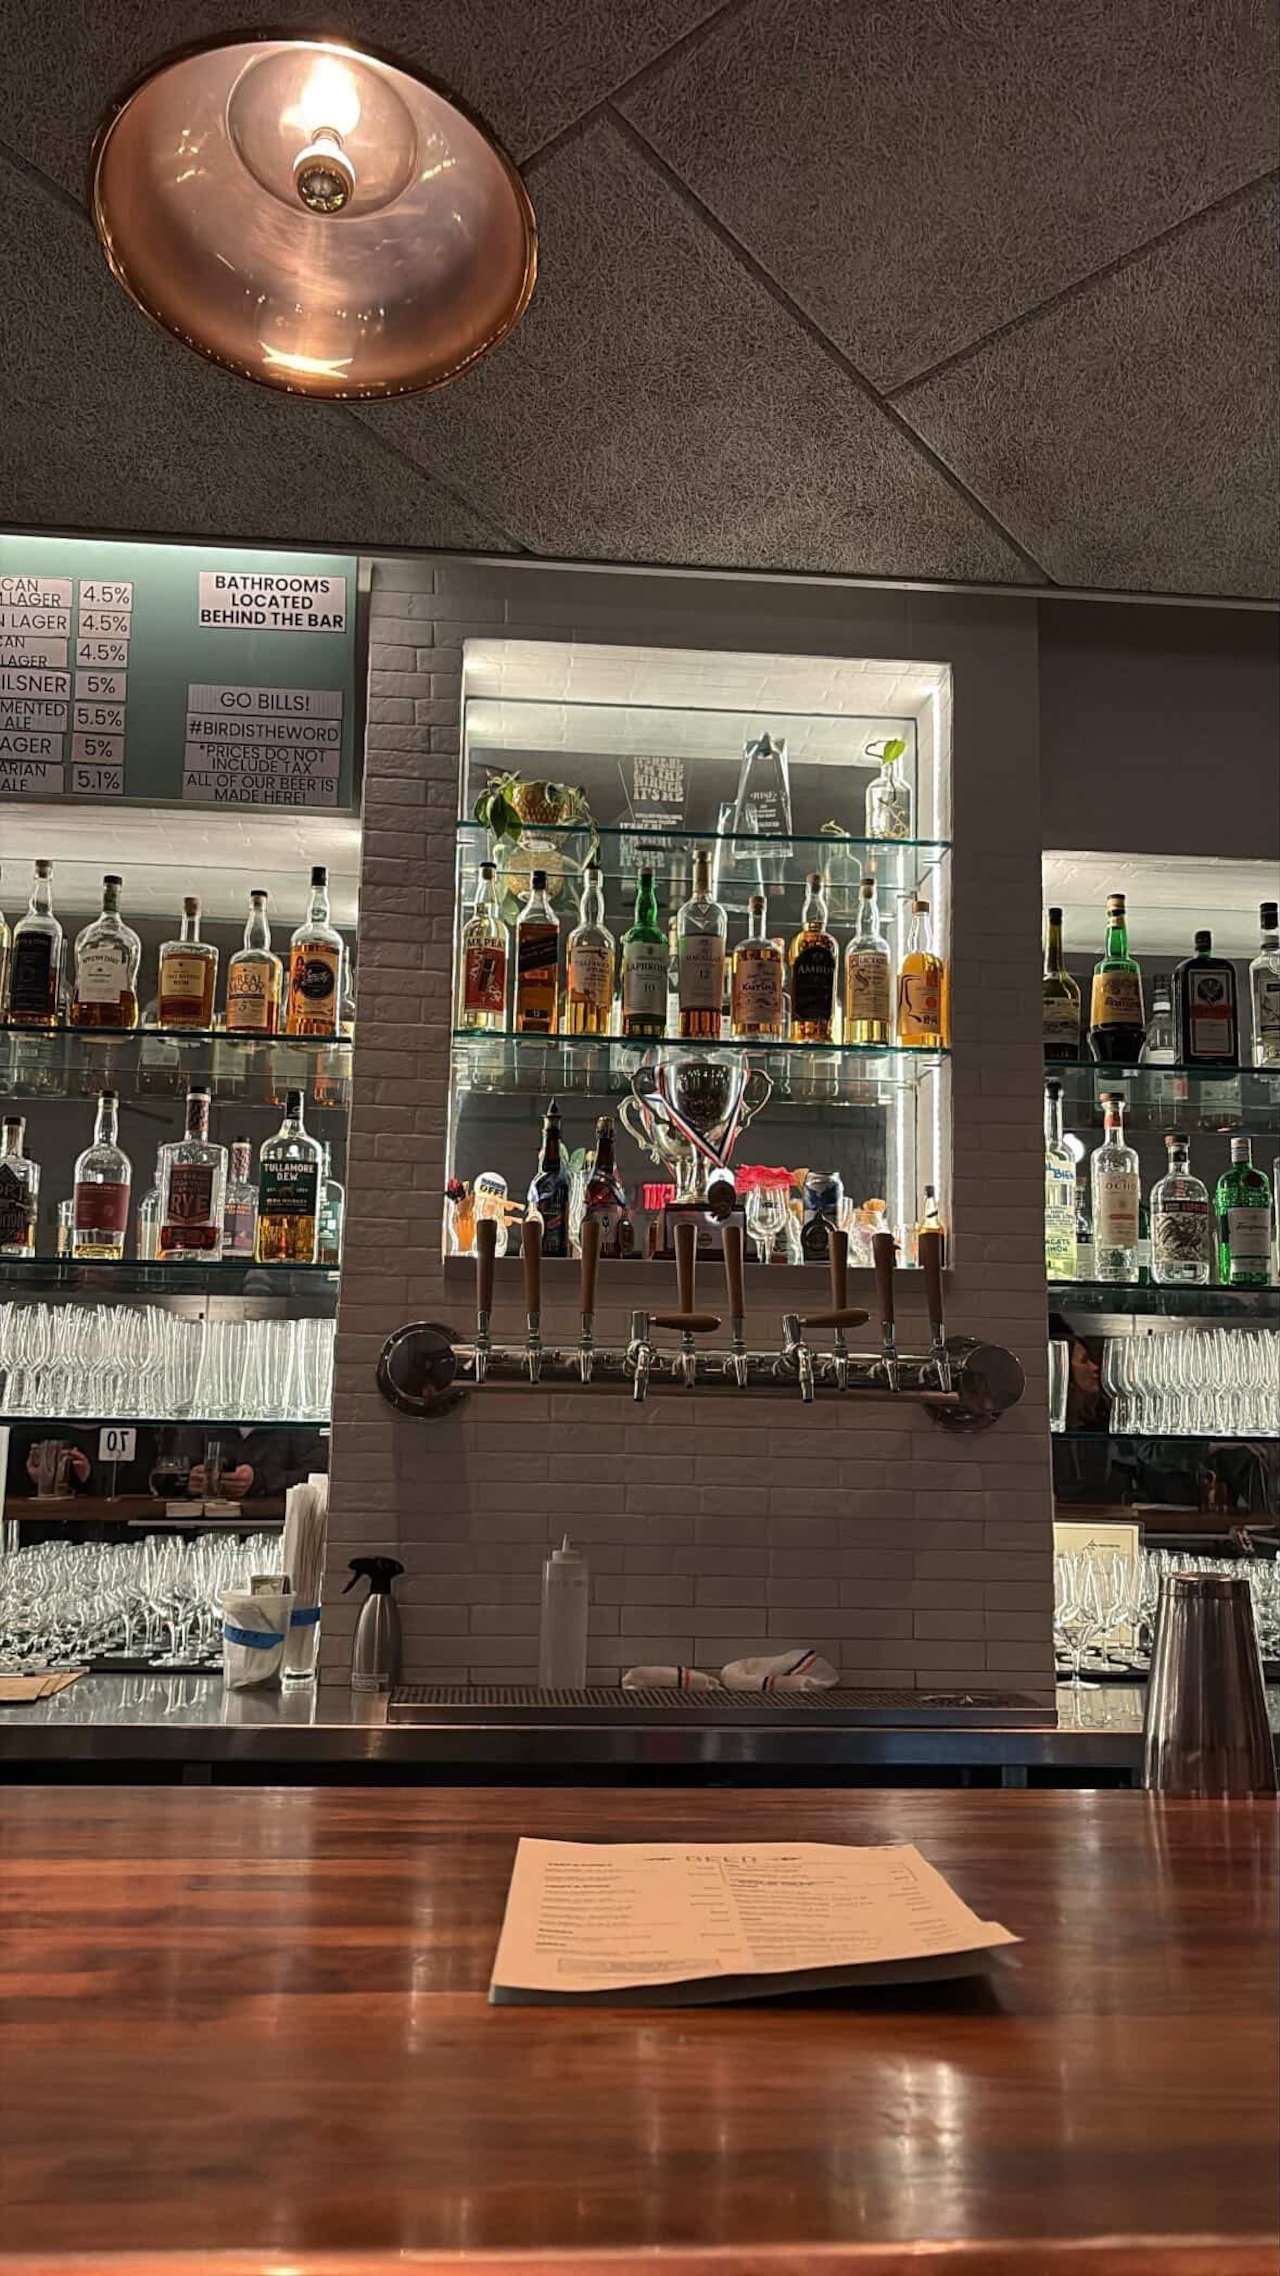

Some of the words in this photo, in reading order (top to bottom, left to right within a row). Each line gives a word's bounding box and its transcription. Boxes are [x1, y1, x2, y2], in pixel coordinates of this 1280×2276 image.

[0, 578, 38, 592] CAN
[215, 576, 330, 593] BATHROOMS
[9, 592, 61, 607] LAGER
[83, 585, 130, 604] 4.5%
[231, 593, 313, 609] LOCATED
[11, 613, 67, 630] LAGER
[82, 615, 127, 632] 4.5%
[200, 609, 266, 625] BEHIND
[271, 612, 303, 626] THE
[308, 614, 344, 628] BAR
[79, 643, 125, 661] 4.5%
[1, 654, 47, 668] LAGER
[2, 674, 67, 693] ILSNER
[88, 676, 115, 694] 5%
[0, 701, 65, 717] MENTED
[220, 692, 252, 708] GO
[258, 693, 310, 711] BILLS!
[4, 716, 31, 730] ALE
[77, 708, 122, 727] 5.5%
[189, 720, 339, 742] #BIRDISTHEWORD
[0, 736, 51, 754] AGER
[84, 739, 112, 758] 5%
[265, 747, 289, 761] DO
[294, 749, 326, 763] NOT
[0, 761, 46, 777] ARIAN
[212, 758, 279, 773] INCLUDE
[284, 761, 312, 775] TAX
[1, 778, 28, 792] ALE
[78, 770, 120, 790] 5.1%
[187, 773, 212, 787] ALL
[217, 774, 237, 788] OF
[242, 775, 275, 790] OUR
[280, 777, 316, 791] BEER
[321, 779, 334, 792] IS
[214, 788, 260, 802] MADE
[264, 790, 306, 805] HERE!
[263, 1163, 315, 1174] TULLAMORE
